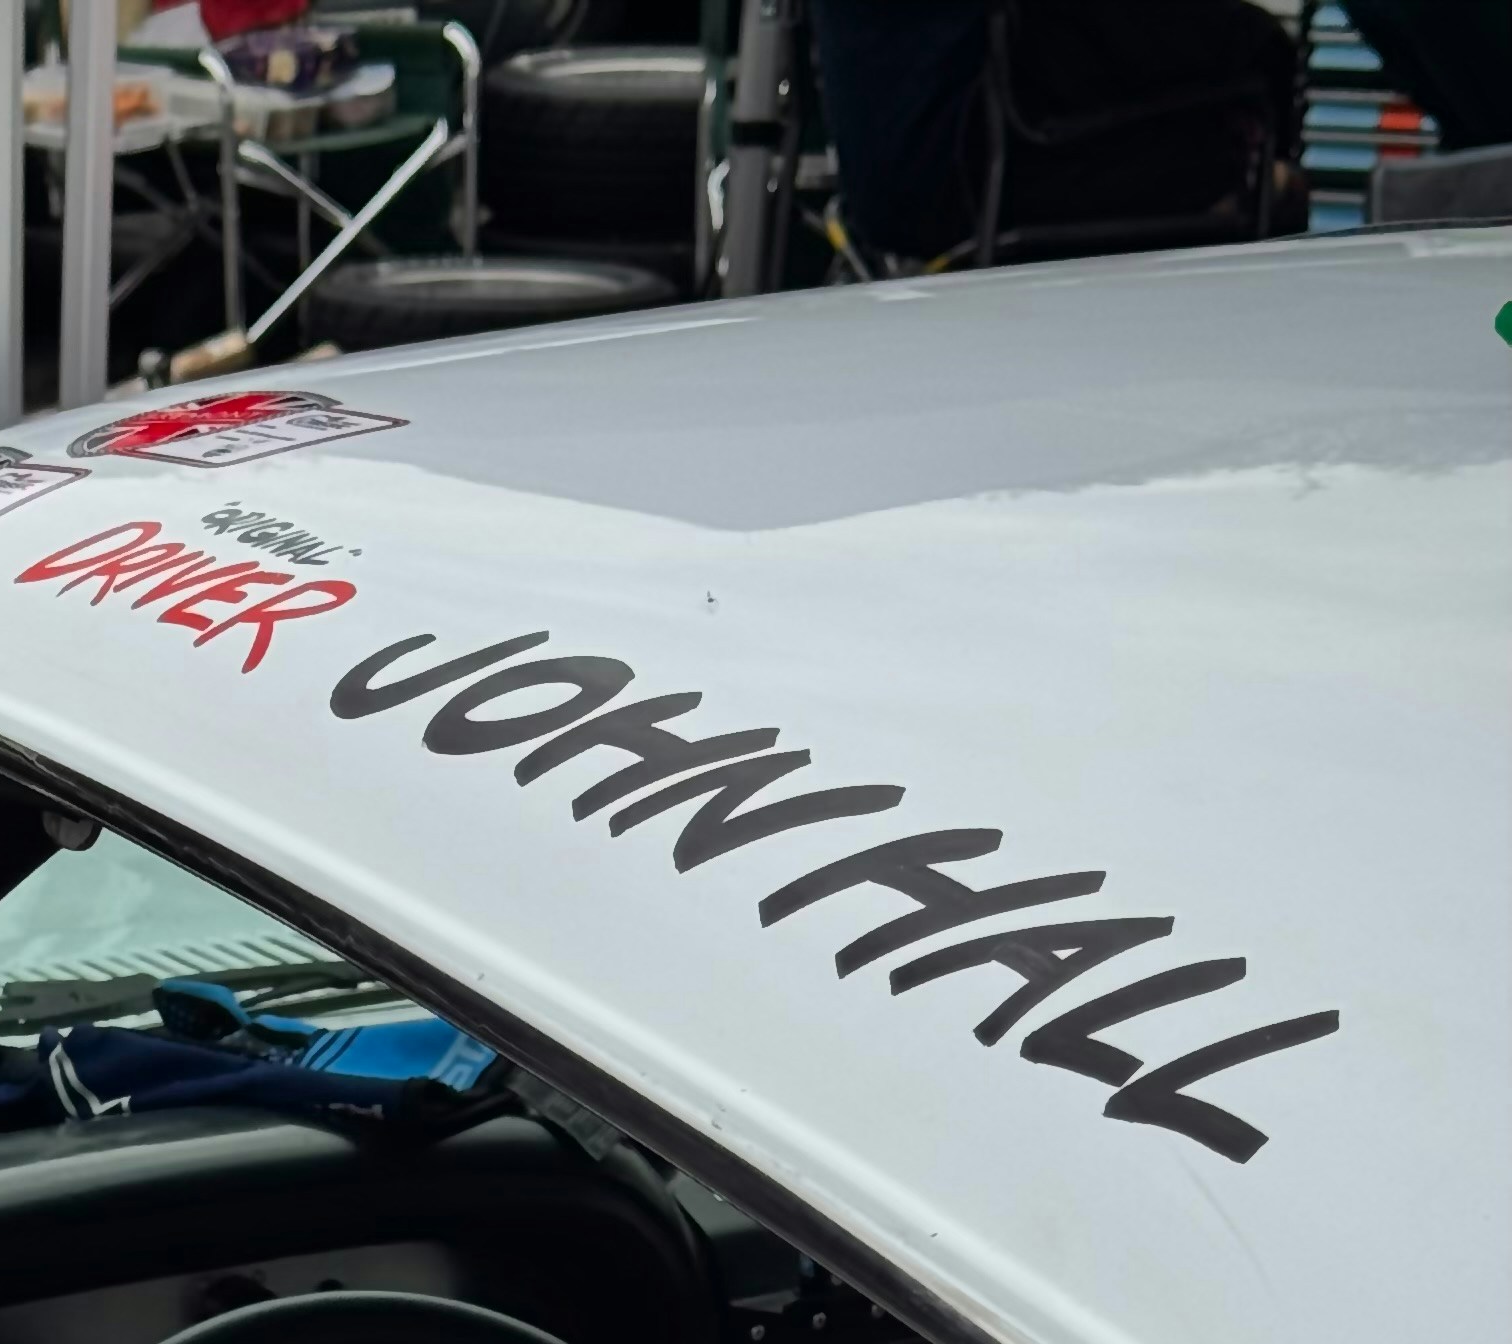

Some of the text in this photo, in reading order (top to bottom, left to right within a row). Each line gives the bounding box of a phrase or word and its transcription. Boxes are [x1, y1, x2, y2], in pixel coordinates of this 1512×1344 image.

[14, 521, 1339, 1165] DRIVER JOHN HALL
